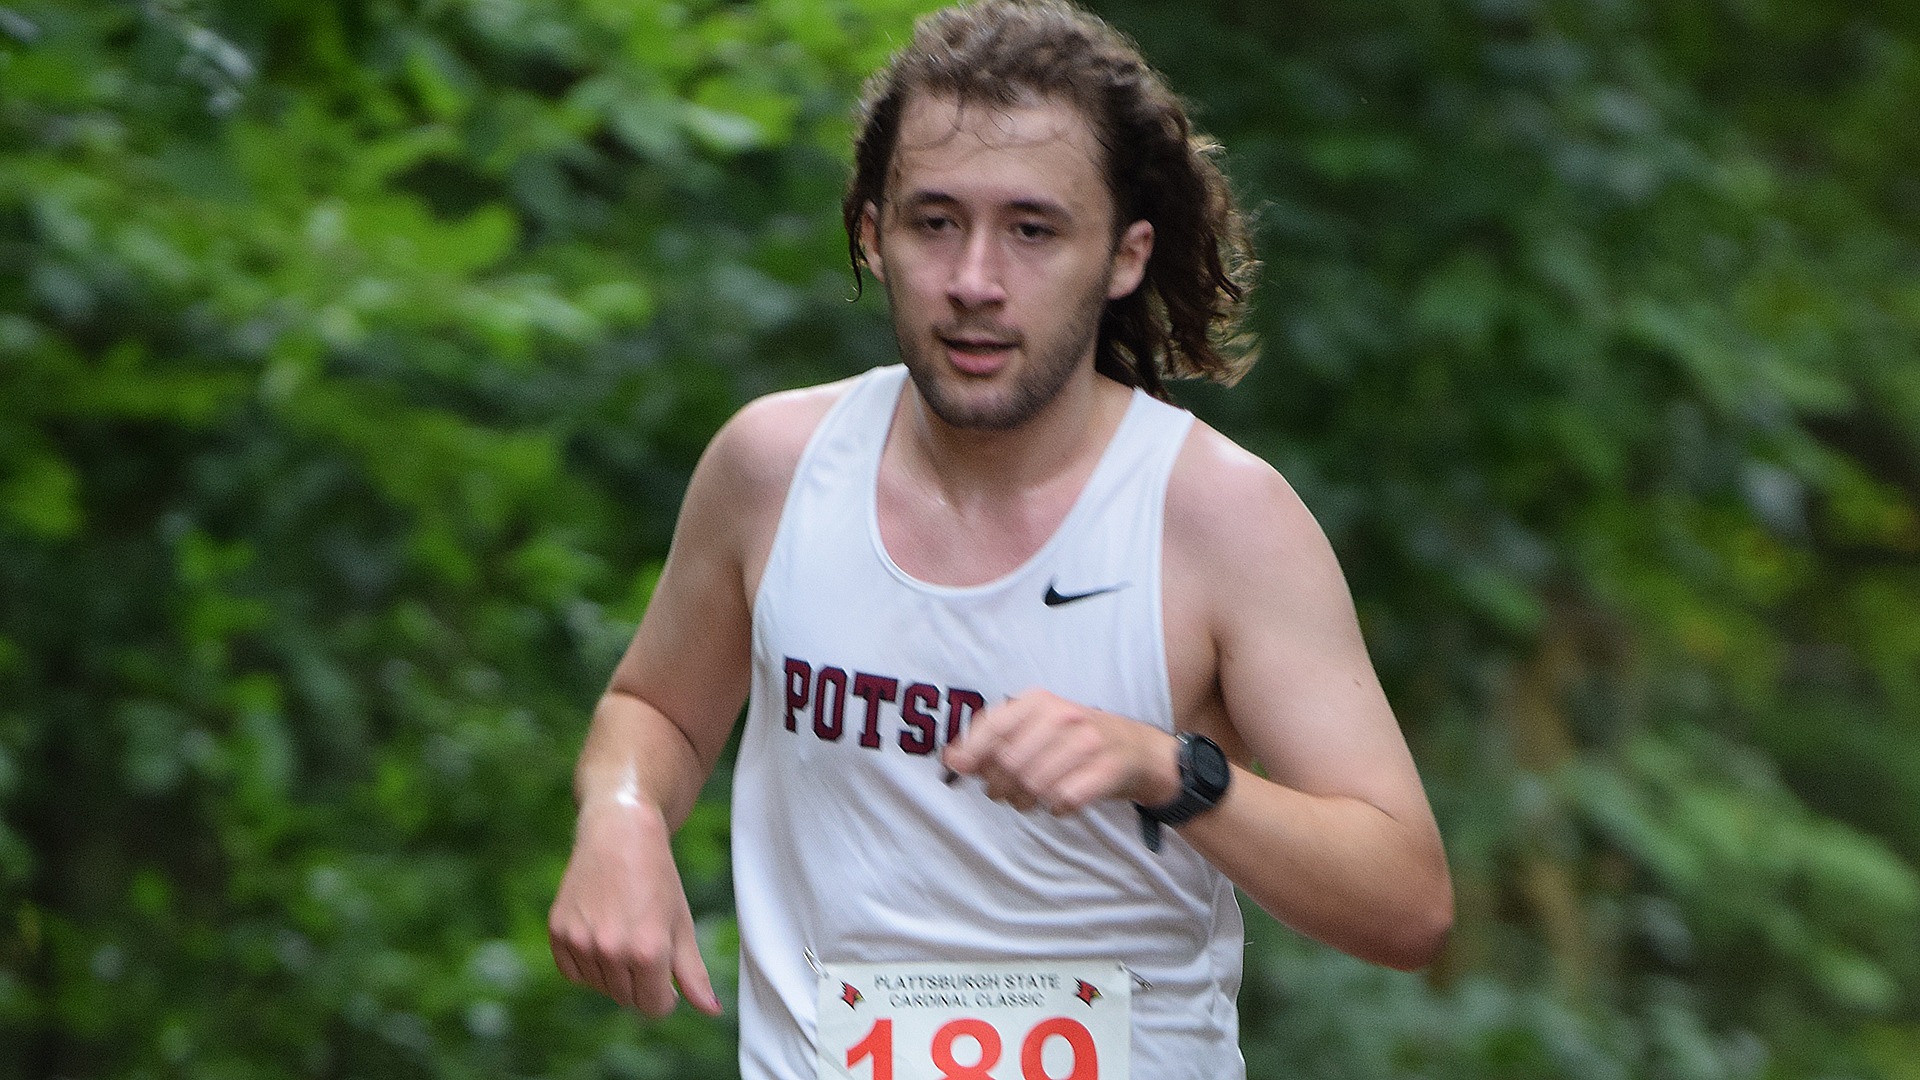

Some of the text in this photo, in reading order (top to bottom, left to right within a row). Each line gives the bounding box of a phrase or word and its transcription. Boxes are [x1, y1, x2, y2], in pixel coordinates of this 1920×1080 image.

[783, 656, 1016, 756] POTSD
[874, 973, 1061, 990] PLATTSBURGH STATE
[888, 992, 1045, 1008] CARDINAL CLASSIC
[846, 1017, 1098, 1080] 189
